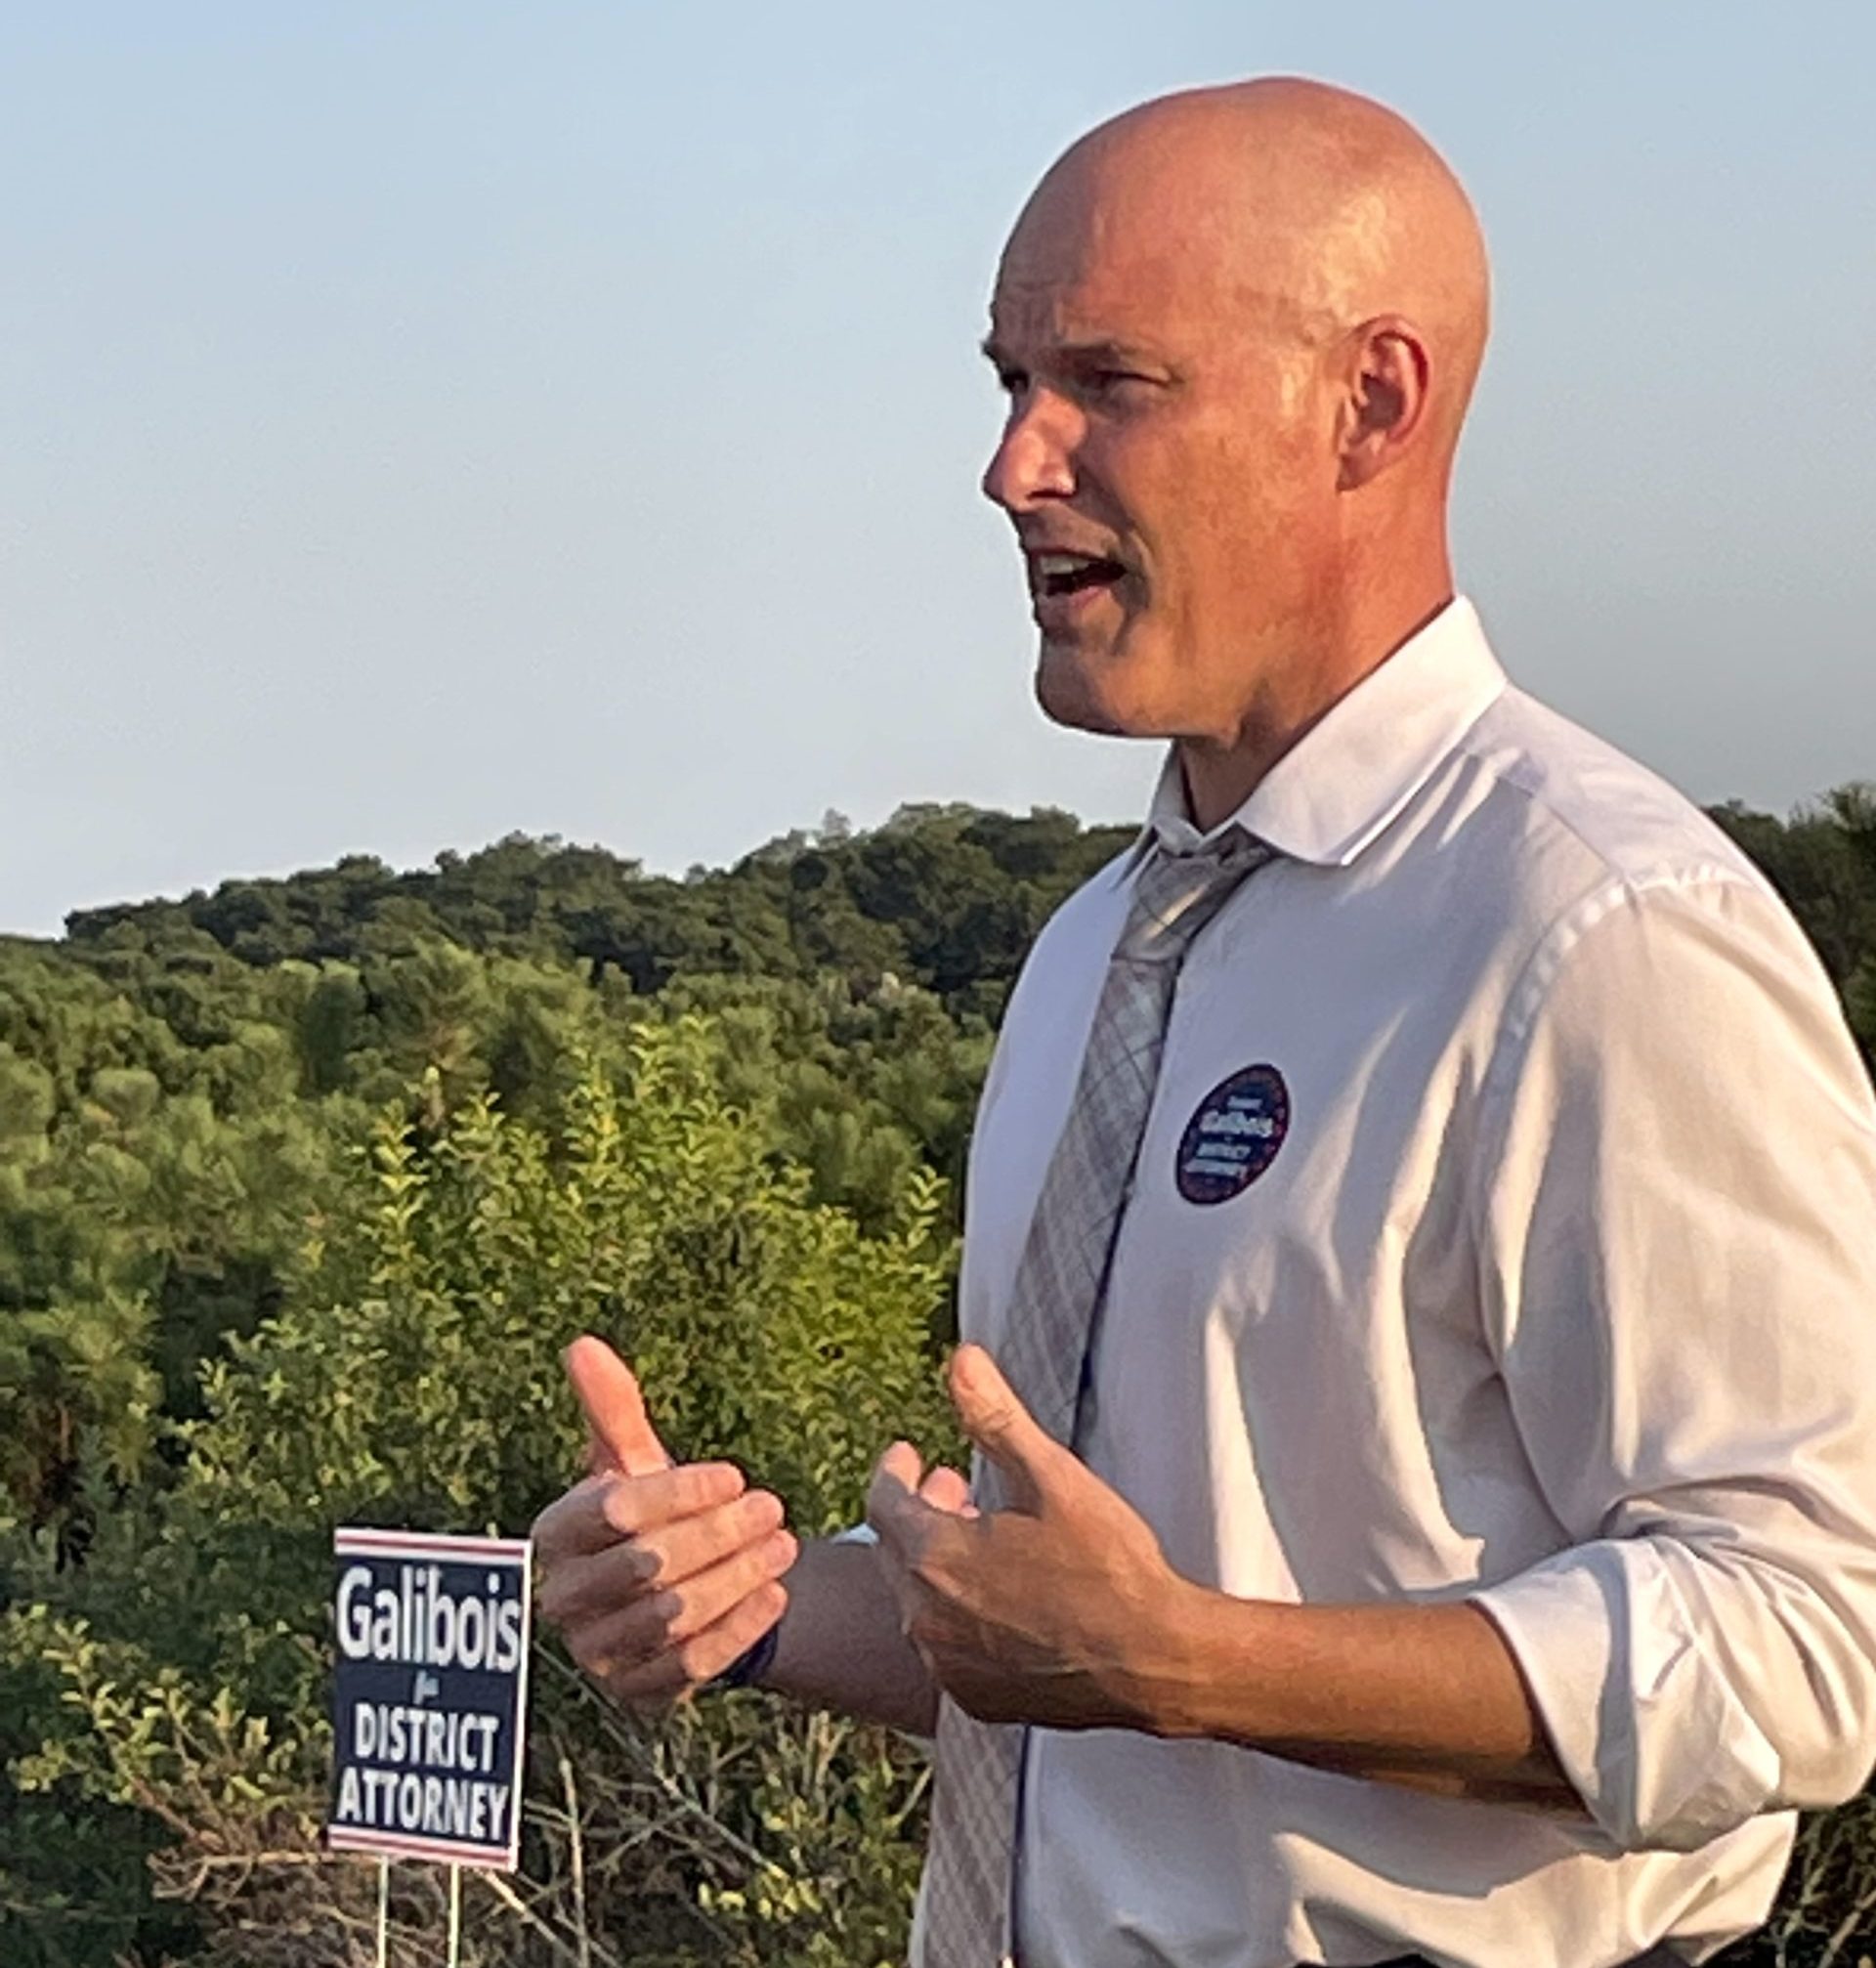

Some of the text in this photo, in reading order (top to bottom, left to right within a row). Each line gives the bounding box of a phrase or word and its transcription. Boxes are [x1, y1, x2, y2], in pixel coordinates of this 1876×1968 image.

[336, 1563, 522, 1673] Galibois
[354, 1702, 499, 1774] DISTRICT
[336, 1766, 509, 1842] ATTORNEY
